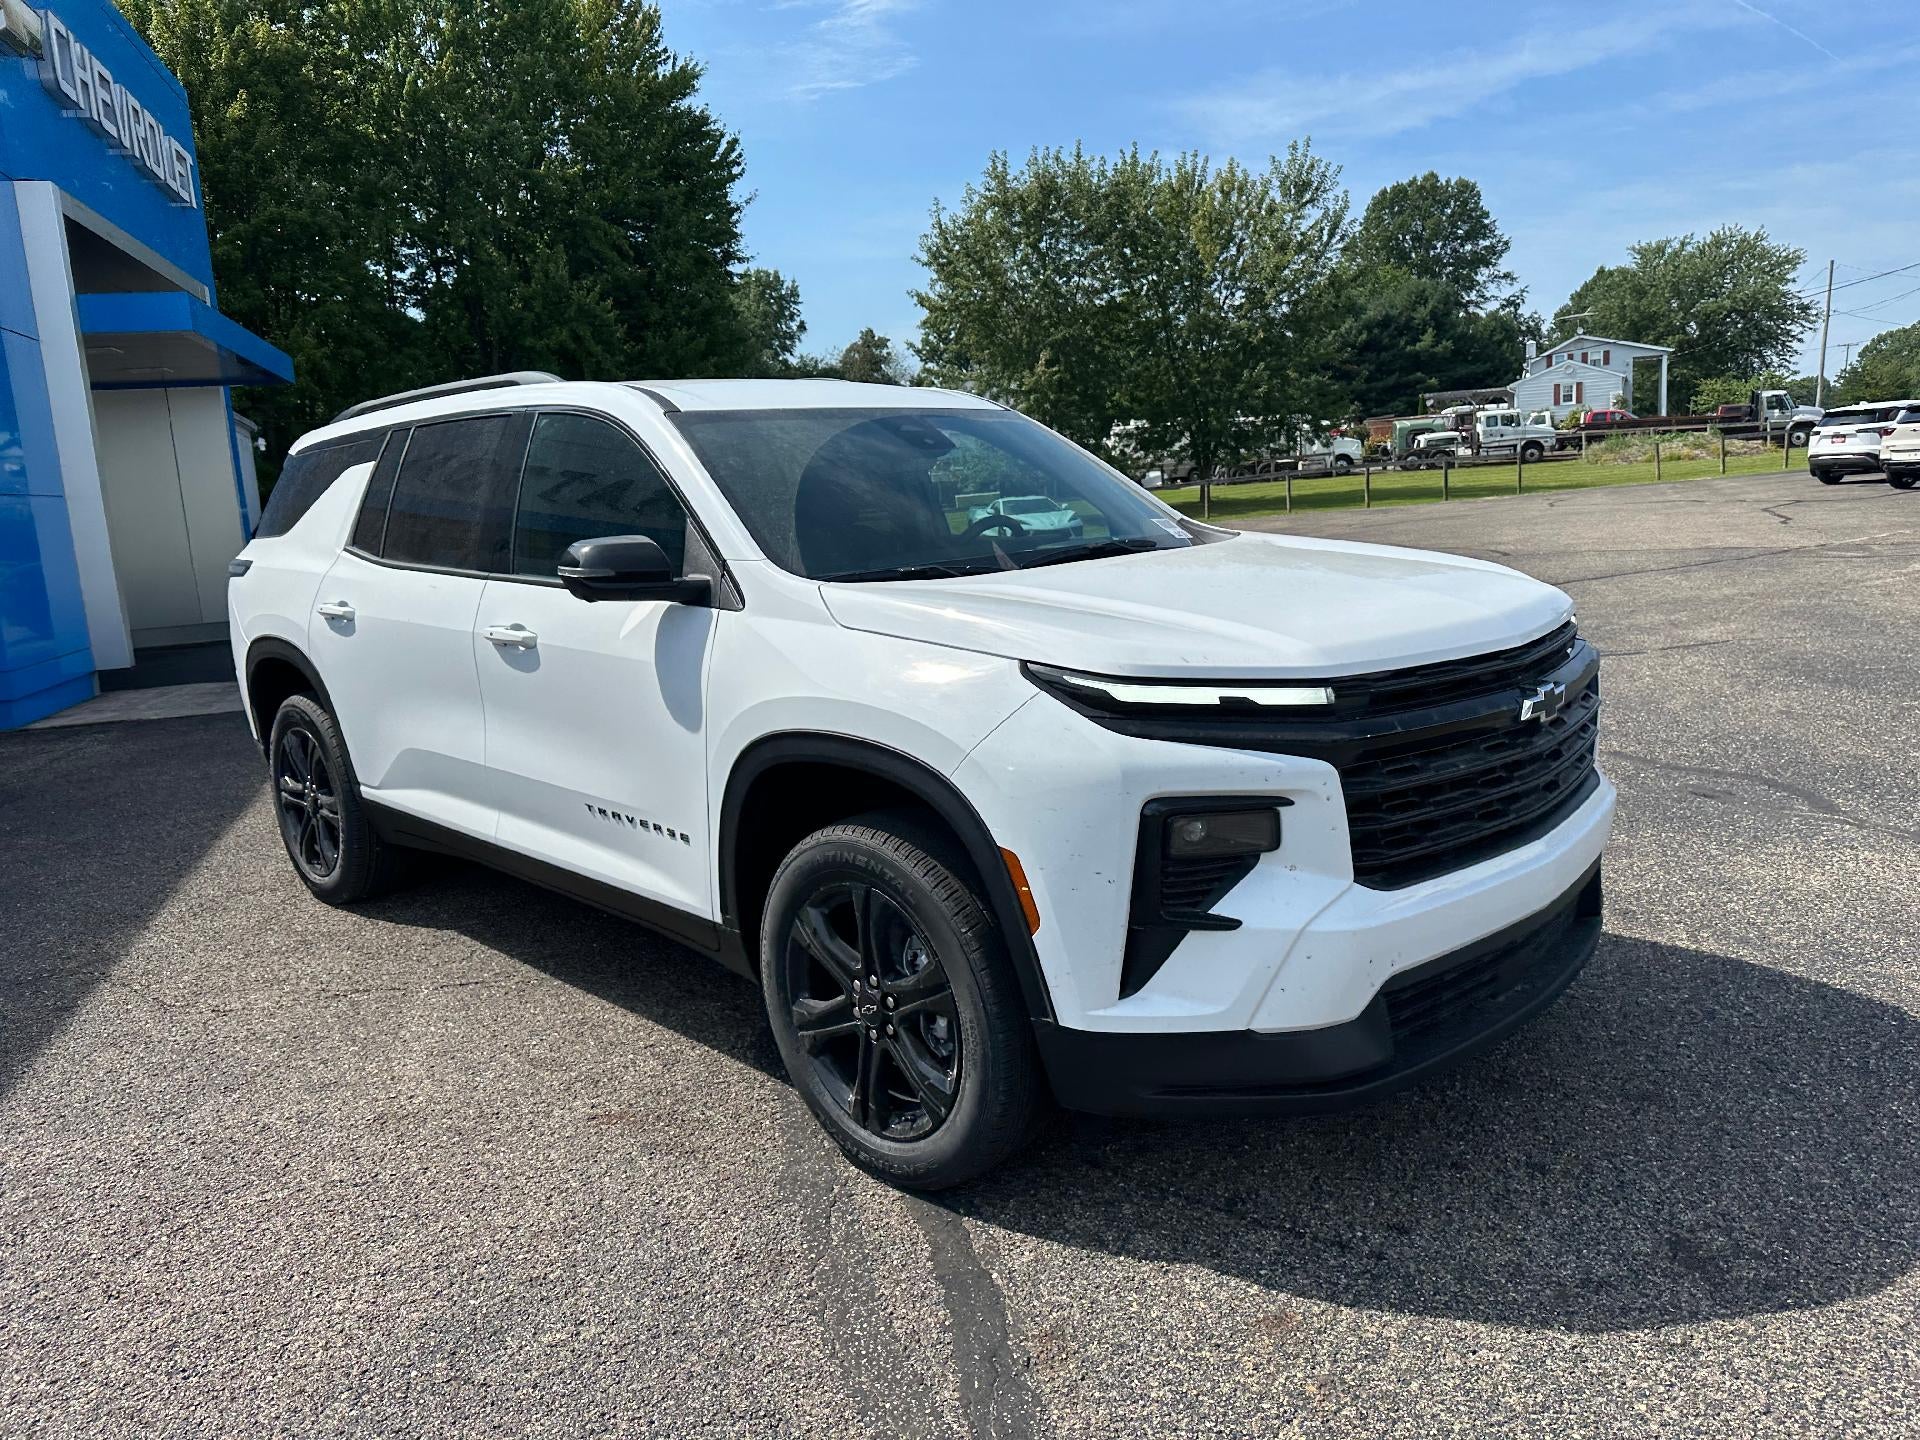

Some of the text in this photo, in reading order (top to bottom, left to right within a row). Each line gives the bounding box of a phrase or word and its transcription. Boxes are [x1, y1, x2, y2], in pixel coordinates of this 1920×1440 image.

[41, 9, 198, 208] CHEVROLET
[584, 803, 690, 844] TRAVERSE
[796, 850, 916, 905] NTINENTAL
